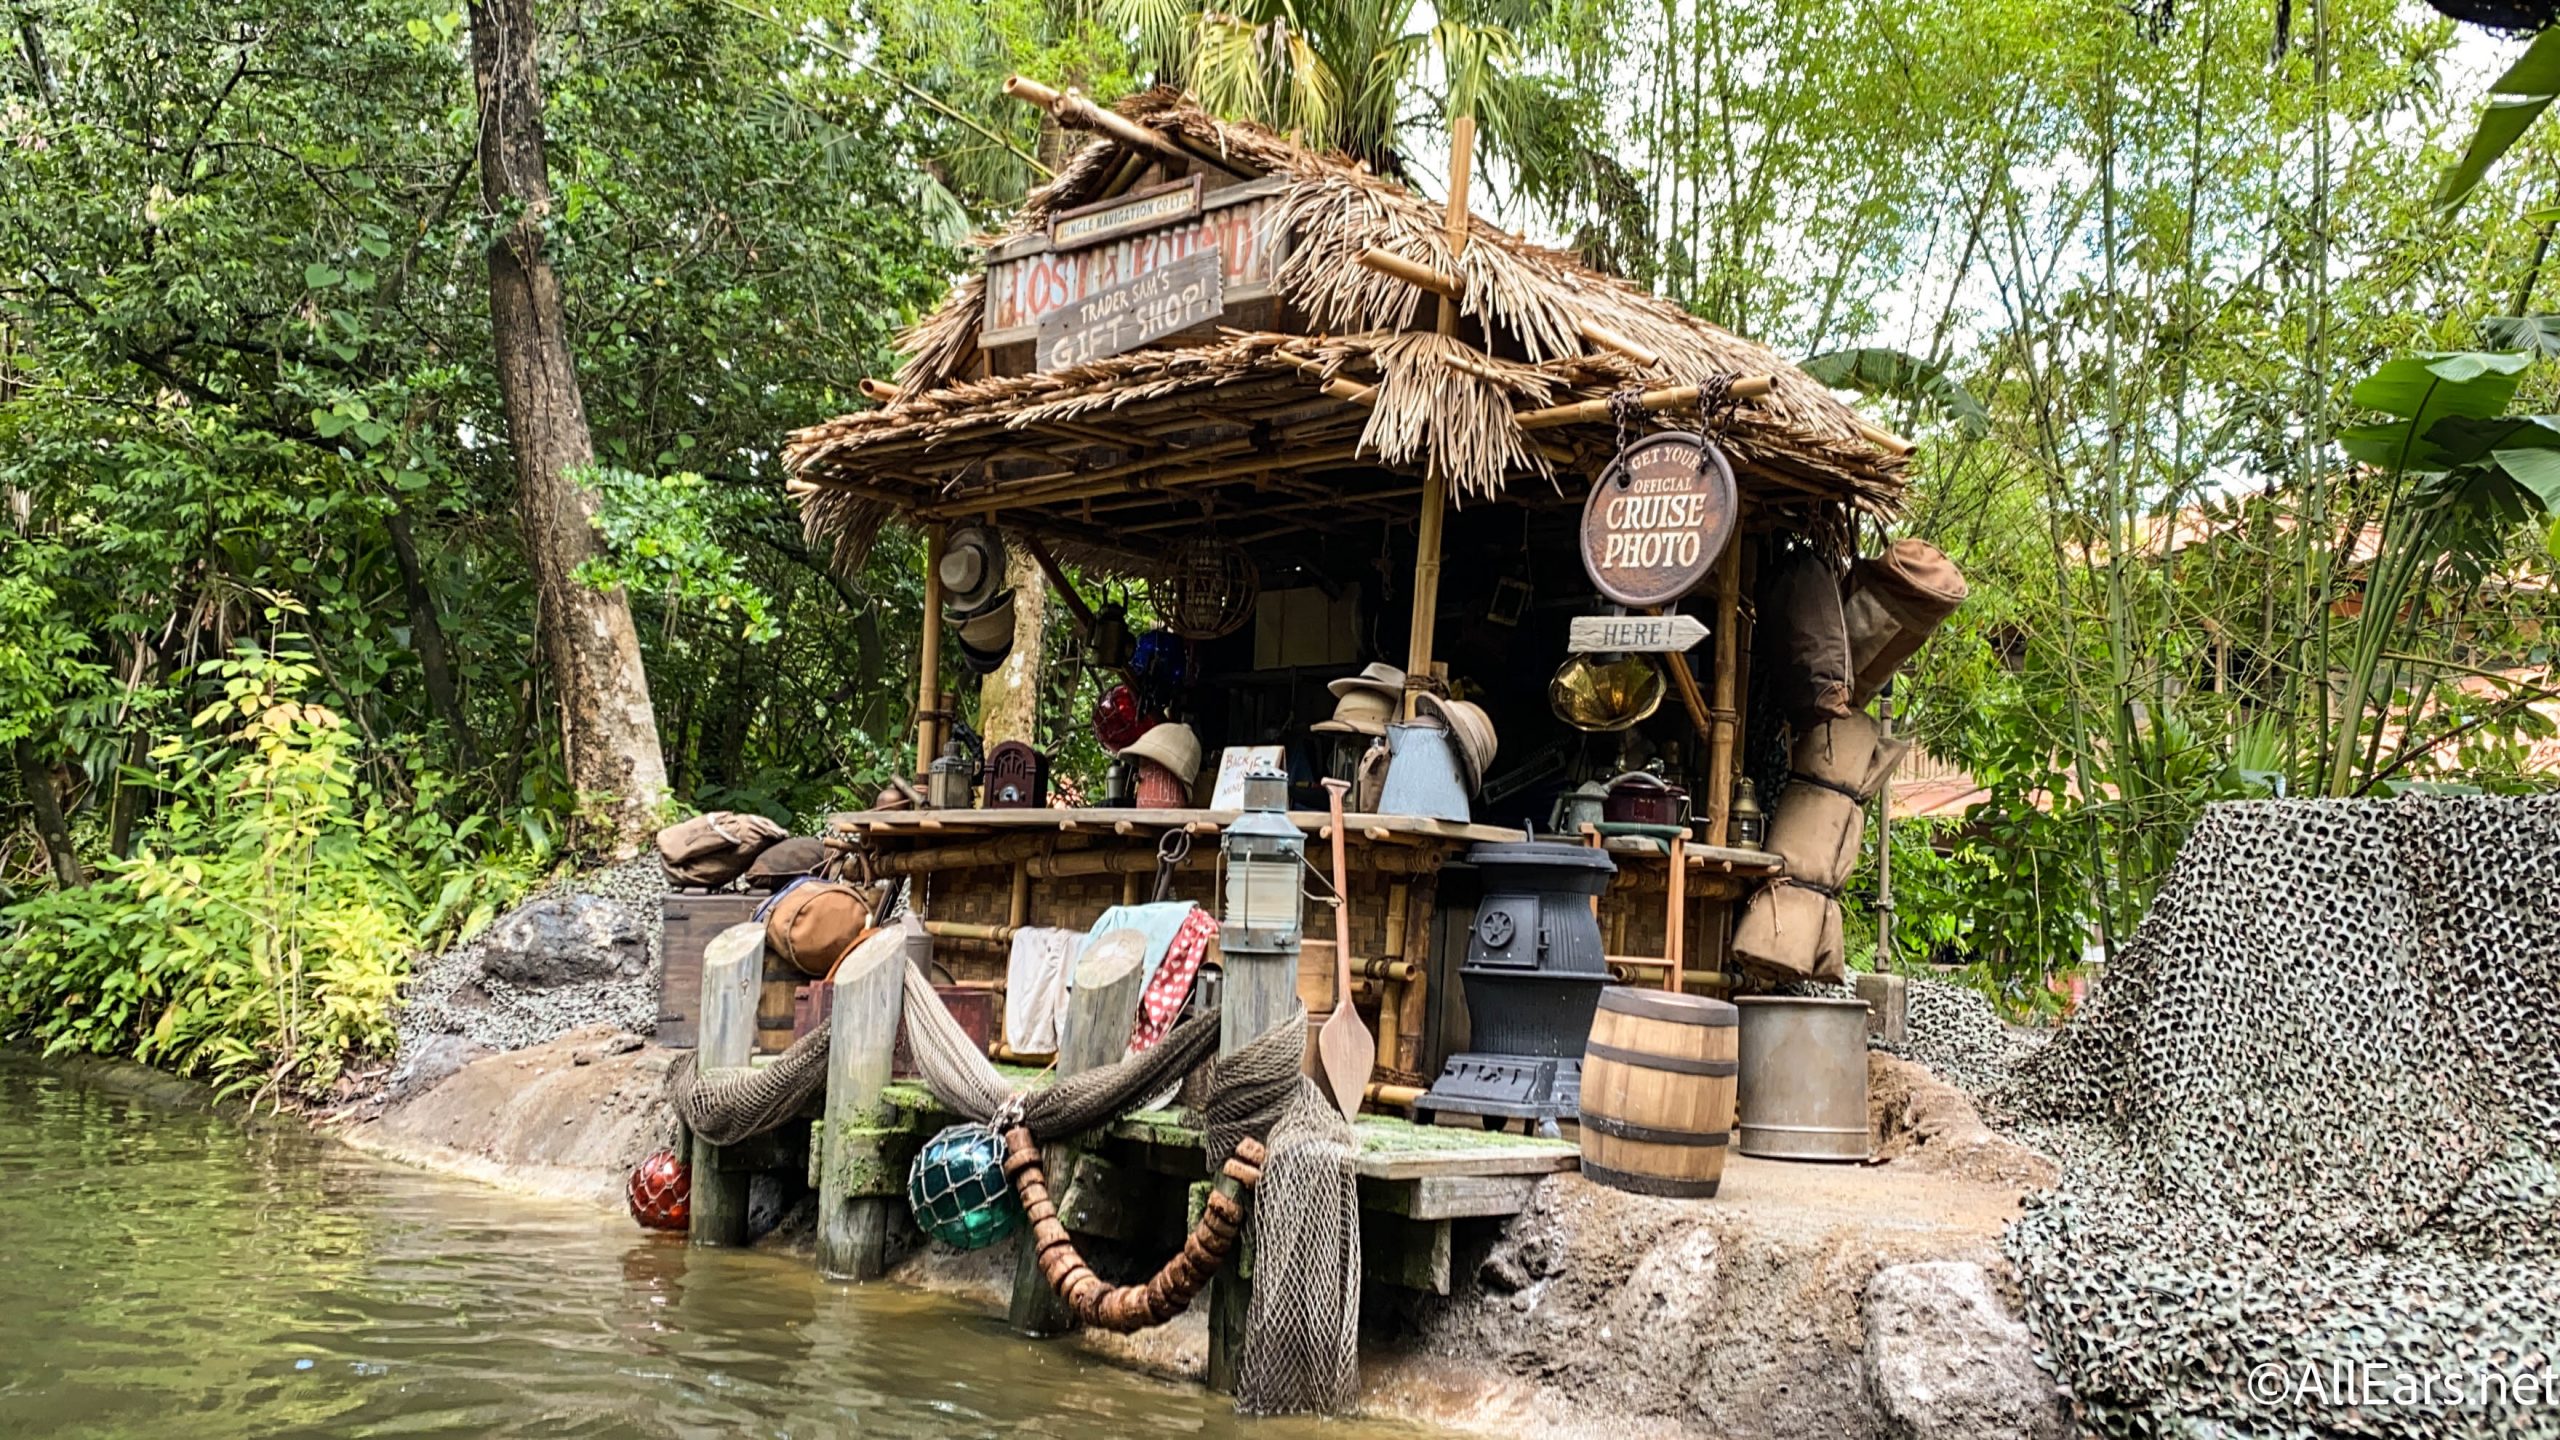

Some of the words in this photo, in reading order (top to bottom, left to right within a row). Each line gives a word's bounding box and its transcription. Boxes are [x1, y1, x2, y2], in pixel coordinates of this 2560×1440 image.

[1060, 221, 1093, 240] JUNGLE
[1096, 203, 1153, 229] NAVIGATION
[1011, 254, 1090, 318] LOST
[1080, 291, 1129, 324] TRADER
[1132, 269, 1170, 304] SAM'S
[1051, 314, 1124, 370] GIFT
[1136, 277, 1207, 340] SHOP!
[1631, 448, 1660, 471] GET
[1663, 446, 1700, 472] YOUR
[1633, 476, 1692, 494] OFFICIAL
[1606, 493, 1707, 530] CRUISE
[1602, 531, 1700, 569] PHOTO
